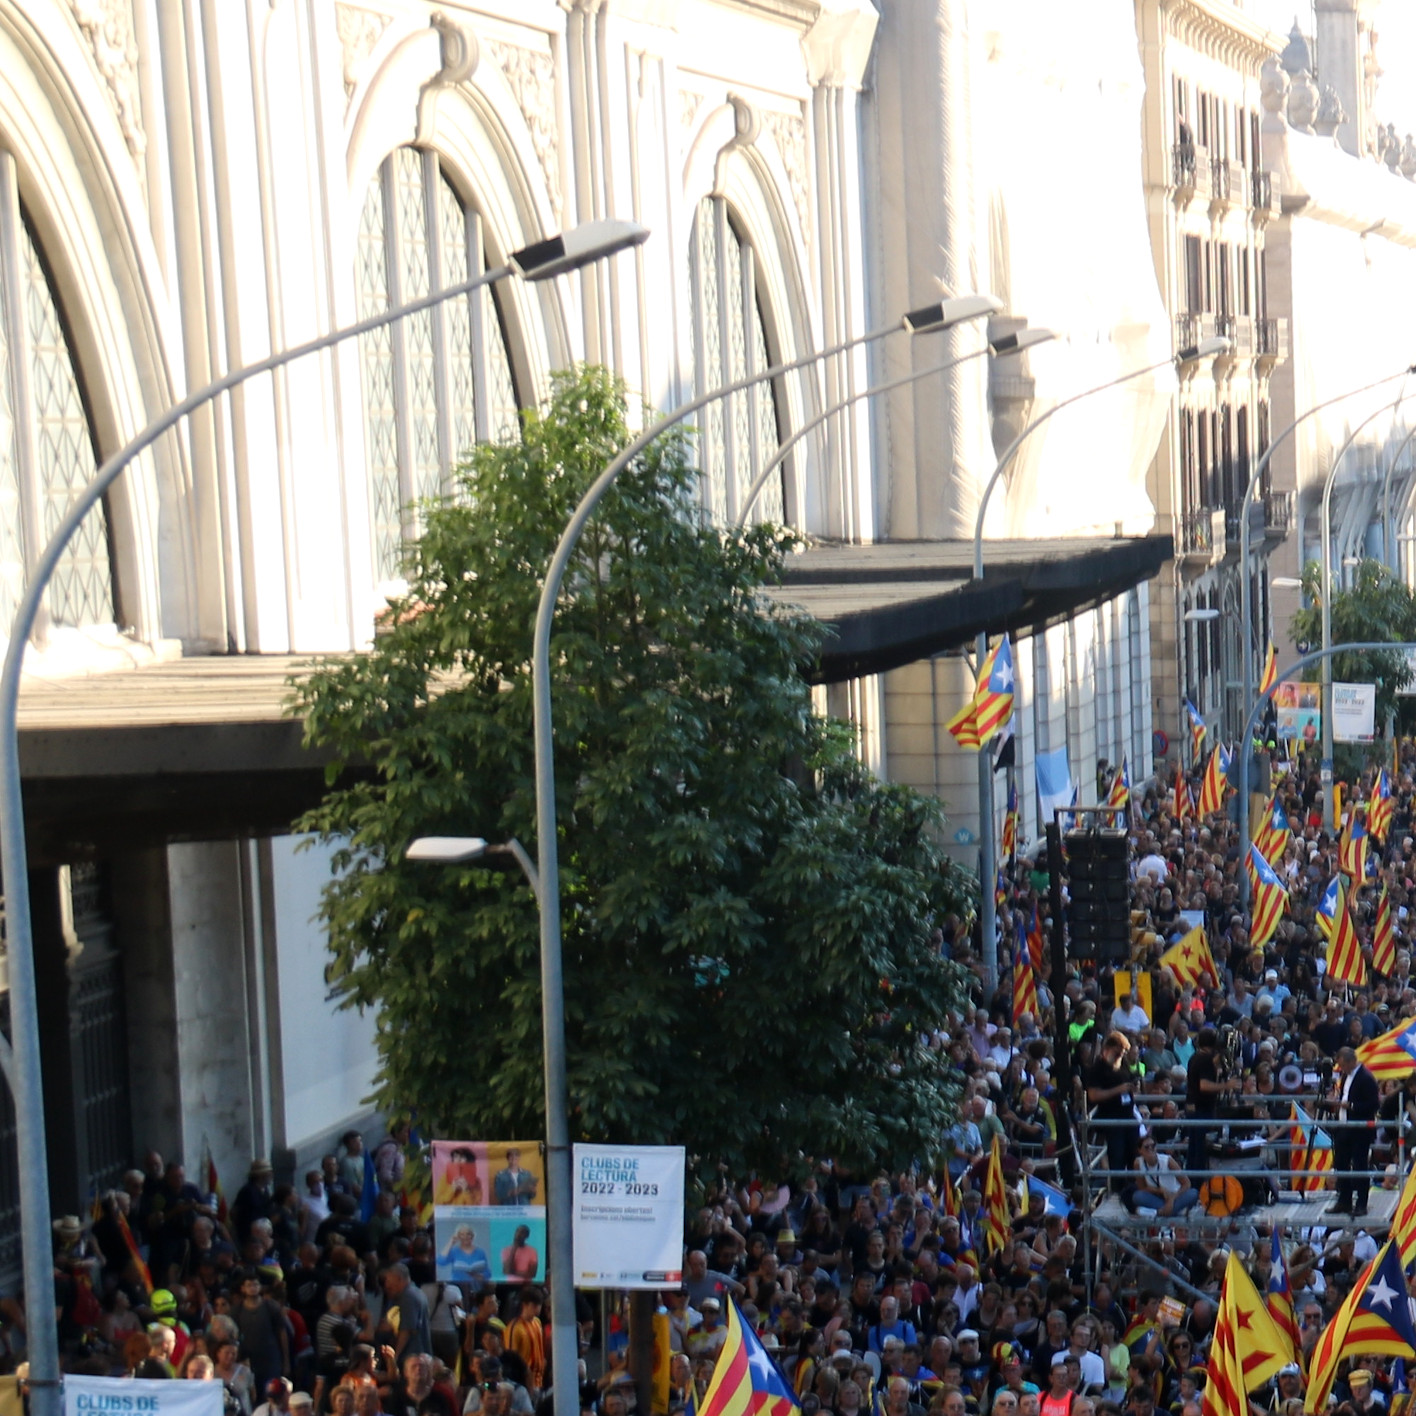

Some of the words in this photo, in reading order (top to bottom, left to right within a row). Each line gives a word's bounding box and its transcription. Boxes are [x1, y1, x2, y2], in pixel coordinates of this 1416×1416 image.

[581, 1156, 620, 1171] CLUBS
[623, 1156, 641, 1171] DE
[581, 1169, 638, 1182] LECTURA
[581, 1182, 615, 1195] 2022
[625, 1183, 659, 1196] 2023
[77, 1393, 133, 1411] CLUBS
[136, 1394, 160, 1412] DE
